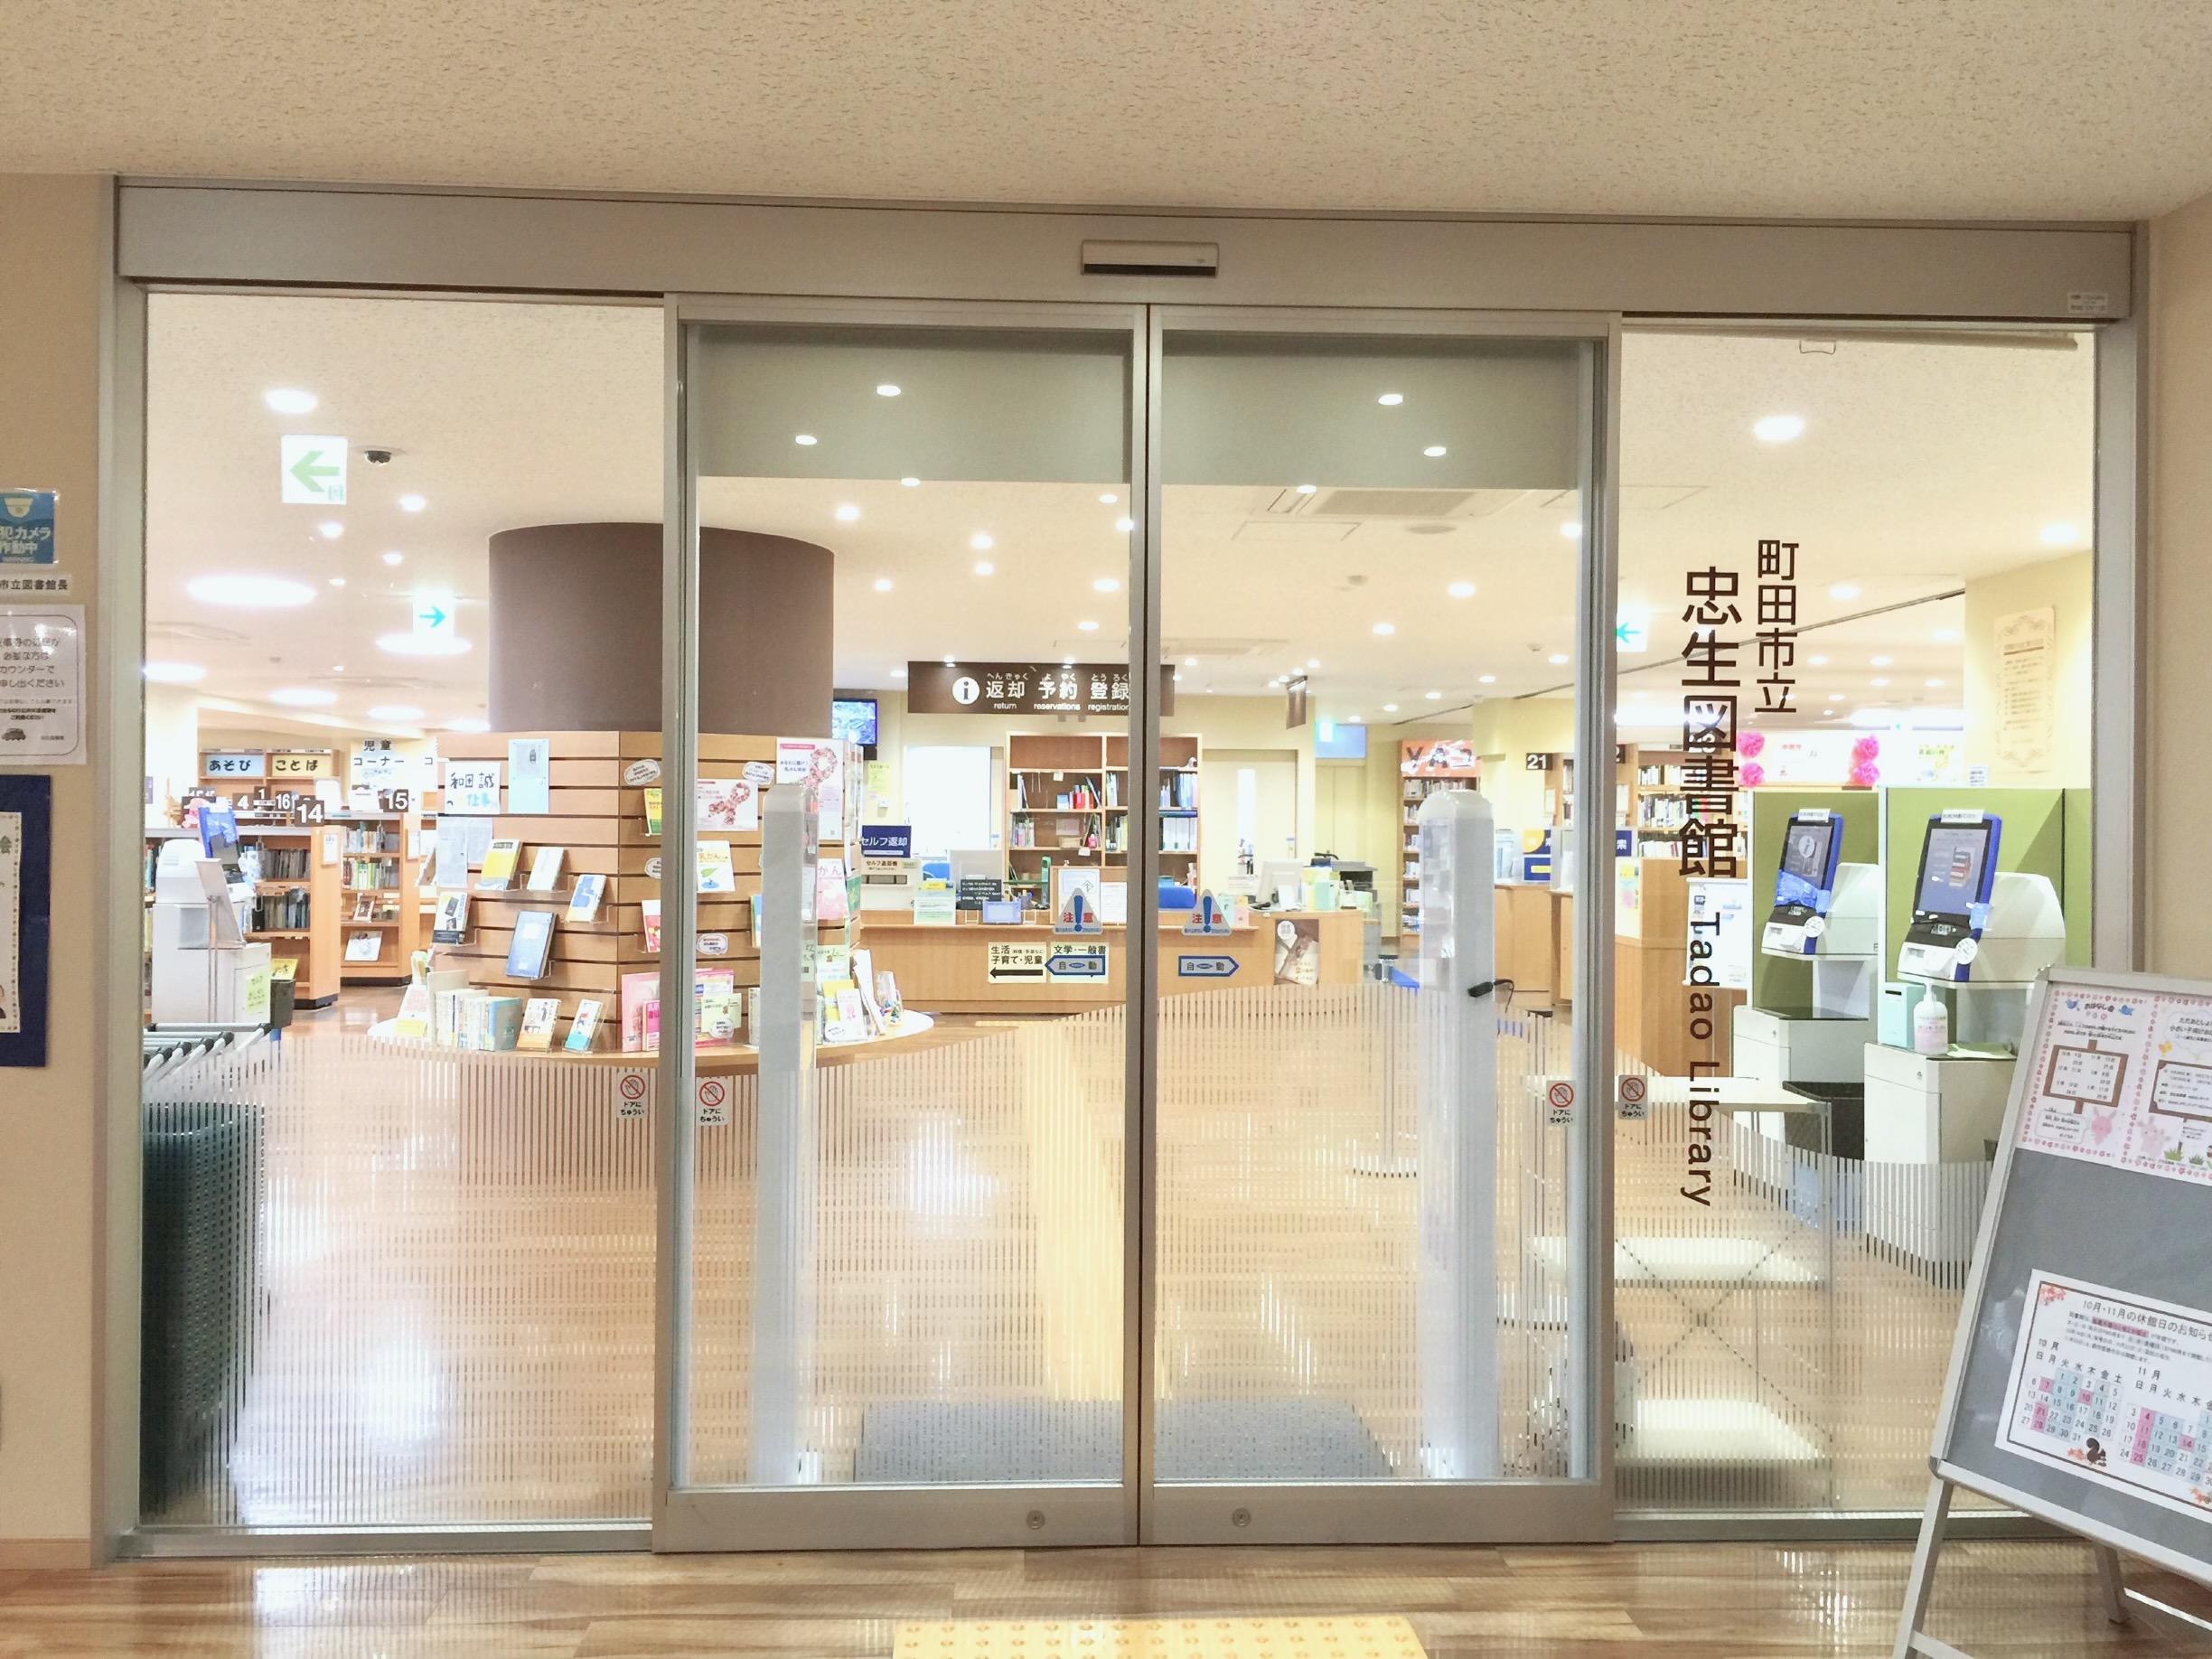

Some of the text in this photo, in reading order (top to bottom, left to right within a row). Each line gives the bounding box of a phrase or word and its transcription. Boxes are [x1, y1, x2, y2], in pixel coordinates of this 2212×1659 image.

[1755, 539, 1799, 713] 町田市立
[986, 680, 1026, 698] 返却
[1038, 681, 1078, 700] 予約
[1090, 682, 1129, 700] 登録
[1034, 702, 1081, 711] reservations
[1679, 566, 1743, 878] 忠生図書館
[363, 739, 391, 752] 児童
[209, 760, 251, 772] あそび
[275, 759, 318, 771] ことば
[353, 756, 404, 766] コーナー
[1527, 754, 1547, 770] 21
[237, 795, 249, 810] 4
[276, 793, 291, 810] 16
[387, 792, 408, 810] 15
[296, 803, 323, 824] 14
[861, 837, 908, 847] セルフ返却
[991, 945, 1011, 954] 生活
[1054, 945, 1106, 954] 文学・一般書
[991, 955, 1043, 965] 子育て・児童
[1690, 912, 1720, 1040] Tadao
[1680, 1062, 1720, 1207] Library
[2037, 1352, 2043, 1360] 日
[2048, 1354, 2056, 1364] 月
[2061, 1359, 2069, 1368] 火
[2101, 1370, 2109, 1380] 金
[2115, 1373, 2122, 1383] 土
[2073, 1377, 2078, 1385] 2
[2041, 1394, 2048, 1402] 14
[2136, 1381, 2143, 1390] 日
[2150, 1383, 2157, 1393] 月
[2162, 1388, 2171, 1399] 火
[2192, 1396, 2201, 1406] 木
[2095, 1397, 2103, 1405] 11
[2109, 1402, 2117, 1411] 12
[2132, 1408, 2135, 1417] 3
[2075, 1420, 2084, 1428] 24
[2088, 1424, 2097, 1432] 25
[2127, 1421, 2135, 1430] 10
[2154, 1431, 2163, 1439] 12
[2169, 1435, 2178, 1444] 13
[2120, 1448, 2129, 1457] 24
[2179, 1453, 2188, 1462] 21
